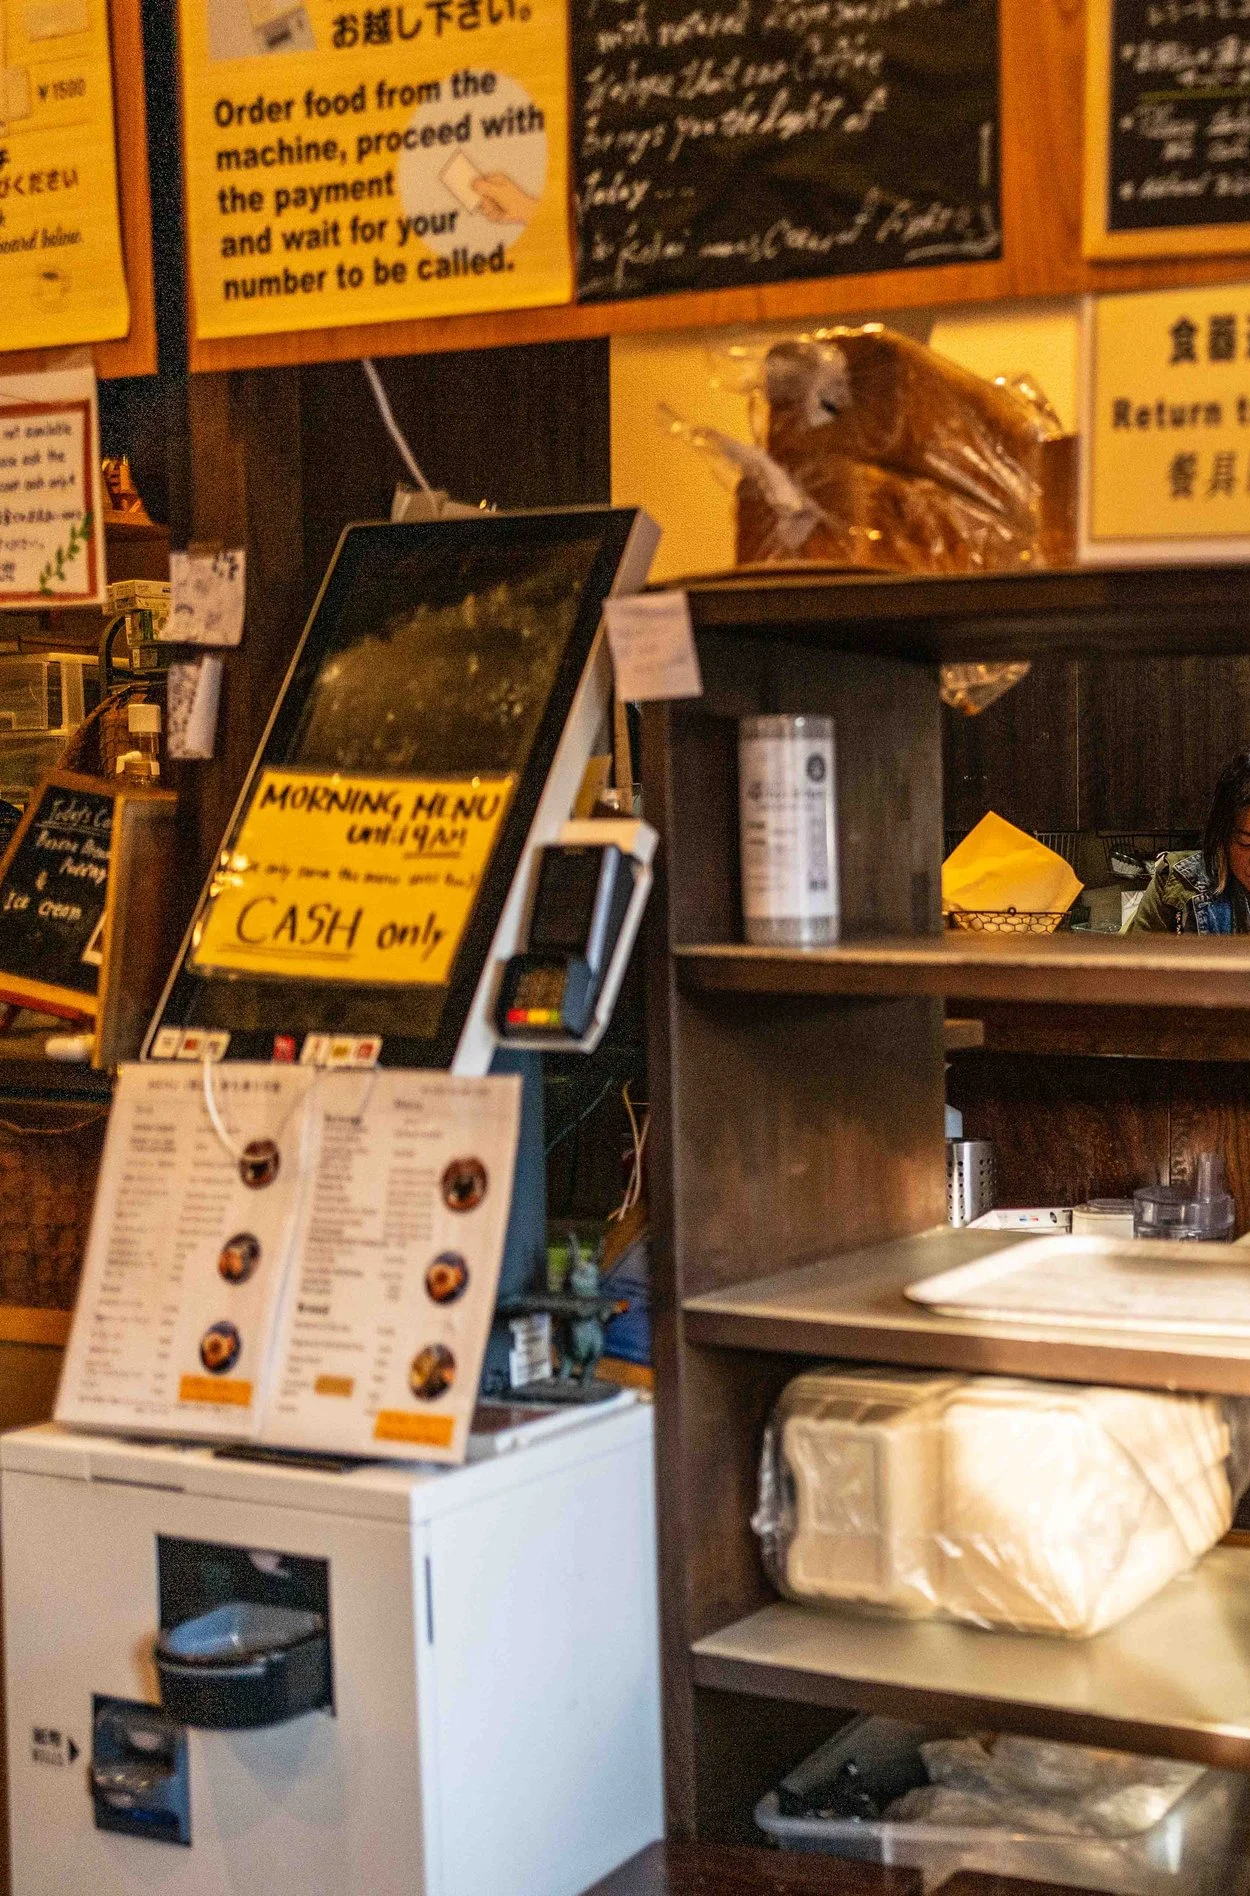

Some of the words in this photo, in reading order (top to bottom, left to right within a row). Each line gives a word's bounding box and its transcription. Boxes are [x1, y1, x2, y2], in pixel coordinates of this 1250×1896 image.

[213, 96, 296, 129] Order
[304, 84, 367, 119] food
[376, 79, 442, 108] from
[450, 68, 498, 98] the
[215, 136, 348, 171] machine,
[356, 113, 472, 164] proceed
[481, 103, 546, 138] with
[217, 185, 265, 215] the
[274, 170, 395, 217] payment
[221, 226, 272, 258] and
[281, 220, 341, 249] wait
[349, 215, 388, 244] for
[396, 209, 459, 247] your
[222, 266, 328, 300] number
[337, 263, 365, 289] to
[373, 256, 408, 286] be
[417, 242, 515, 282] called.
[1112, 396, 1223, 431] Return
[259, 783, 403, 822] MORNING
[410, 792, 501, 822] MENU
[235, 895, 364, 949] CASH
[376, 910, 447, 962] only
